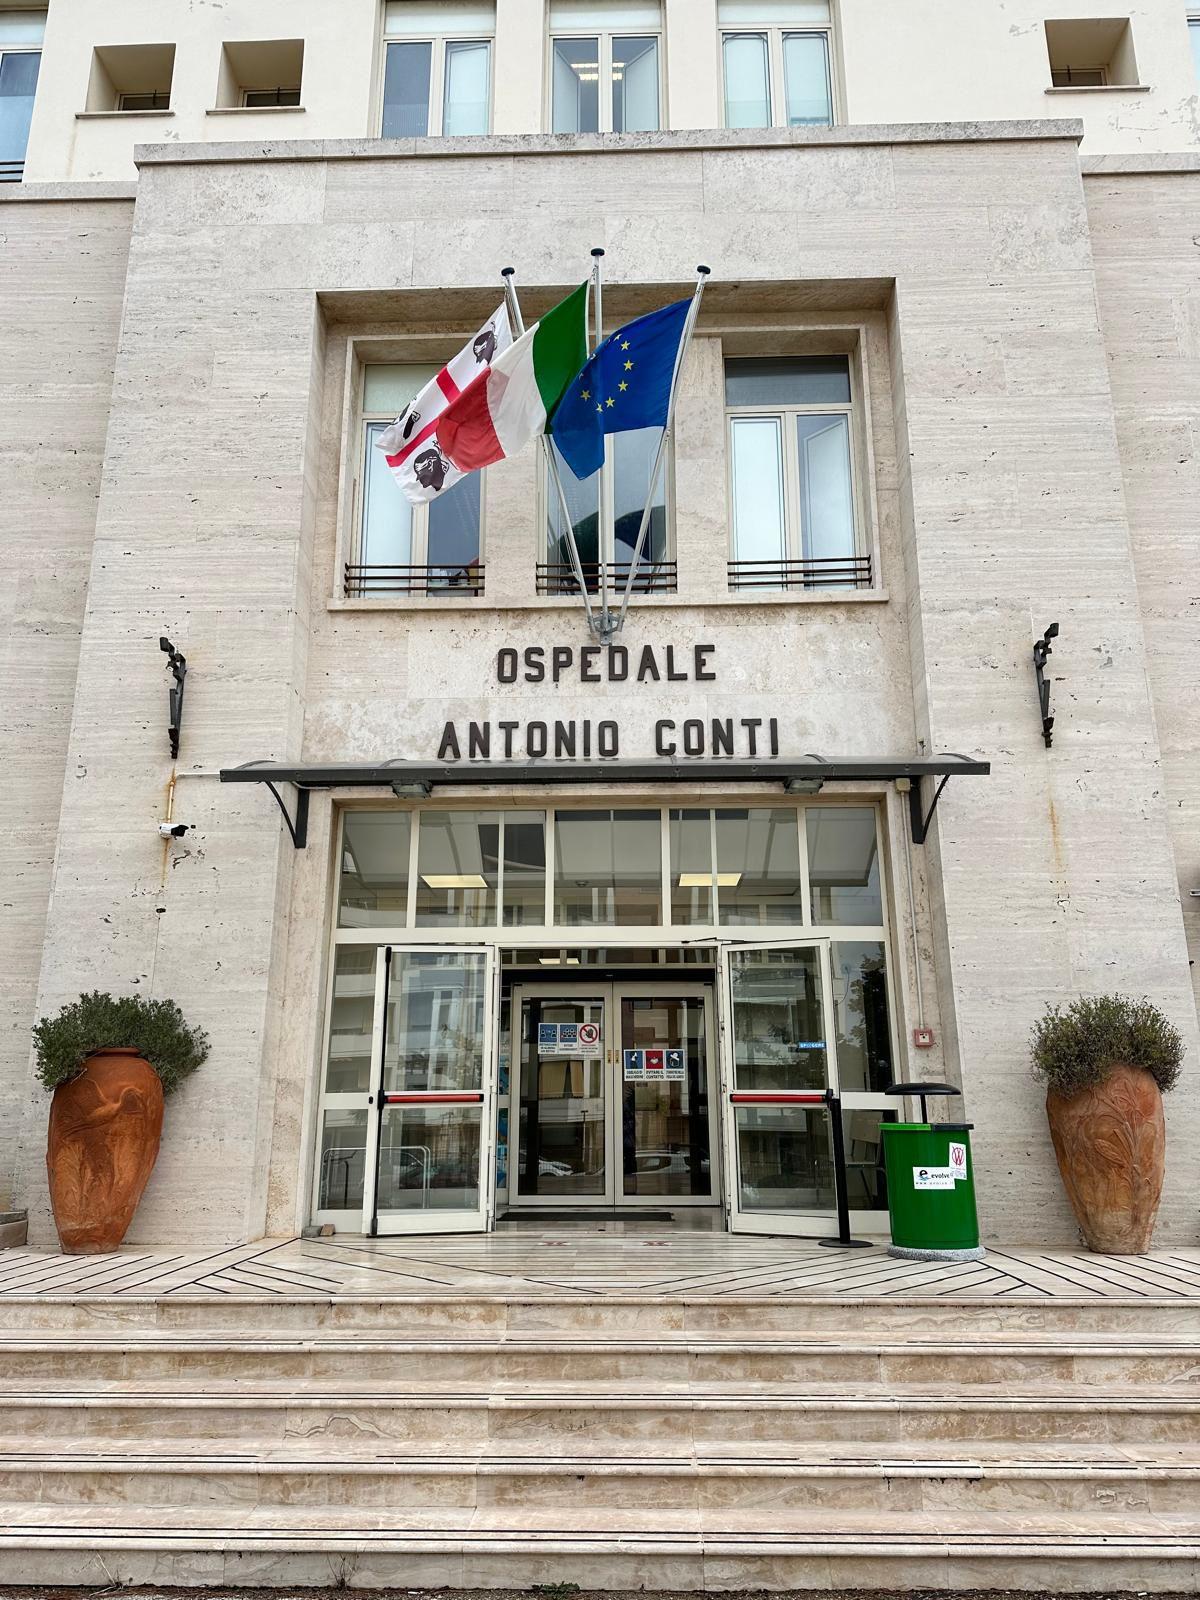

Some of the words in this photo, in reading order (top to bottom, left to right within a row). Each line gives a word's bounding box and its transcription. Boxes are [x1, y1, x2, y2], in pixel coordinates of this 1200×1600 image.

[497, 644, 716, 683] OSPEDALE
[437, 719, 619, 758] ANTONIO
[655, 718, 779, 757] CONTI
